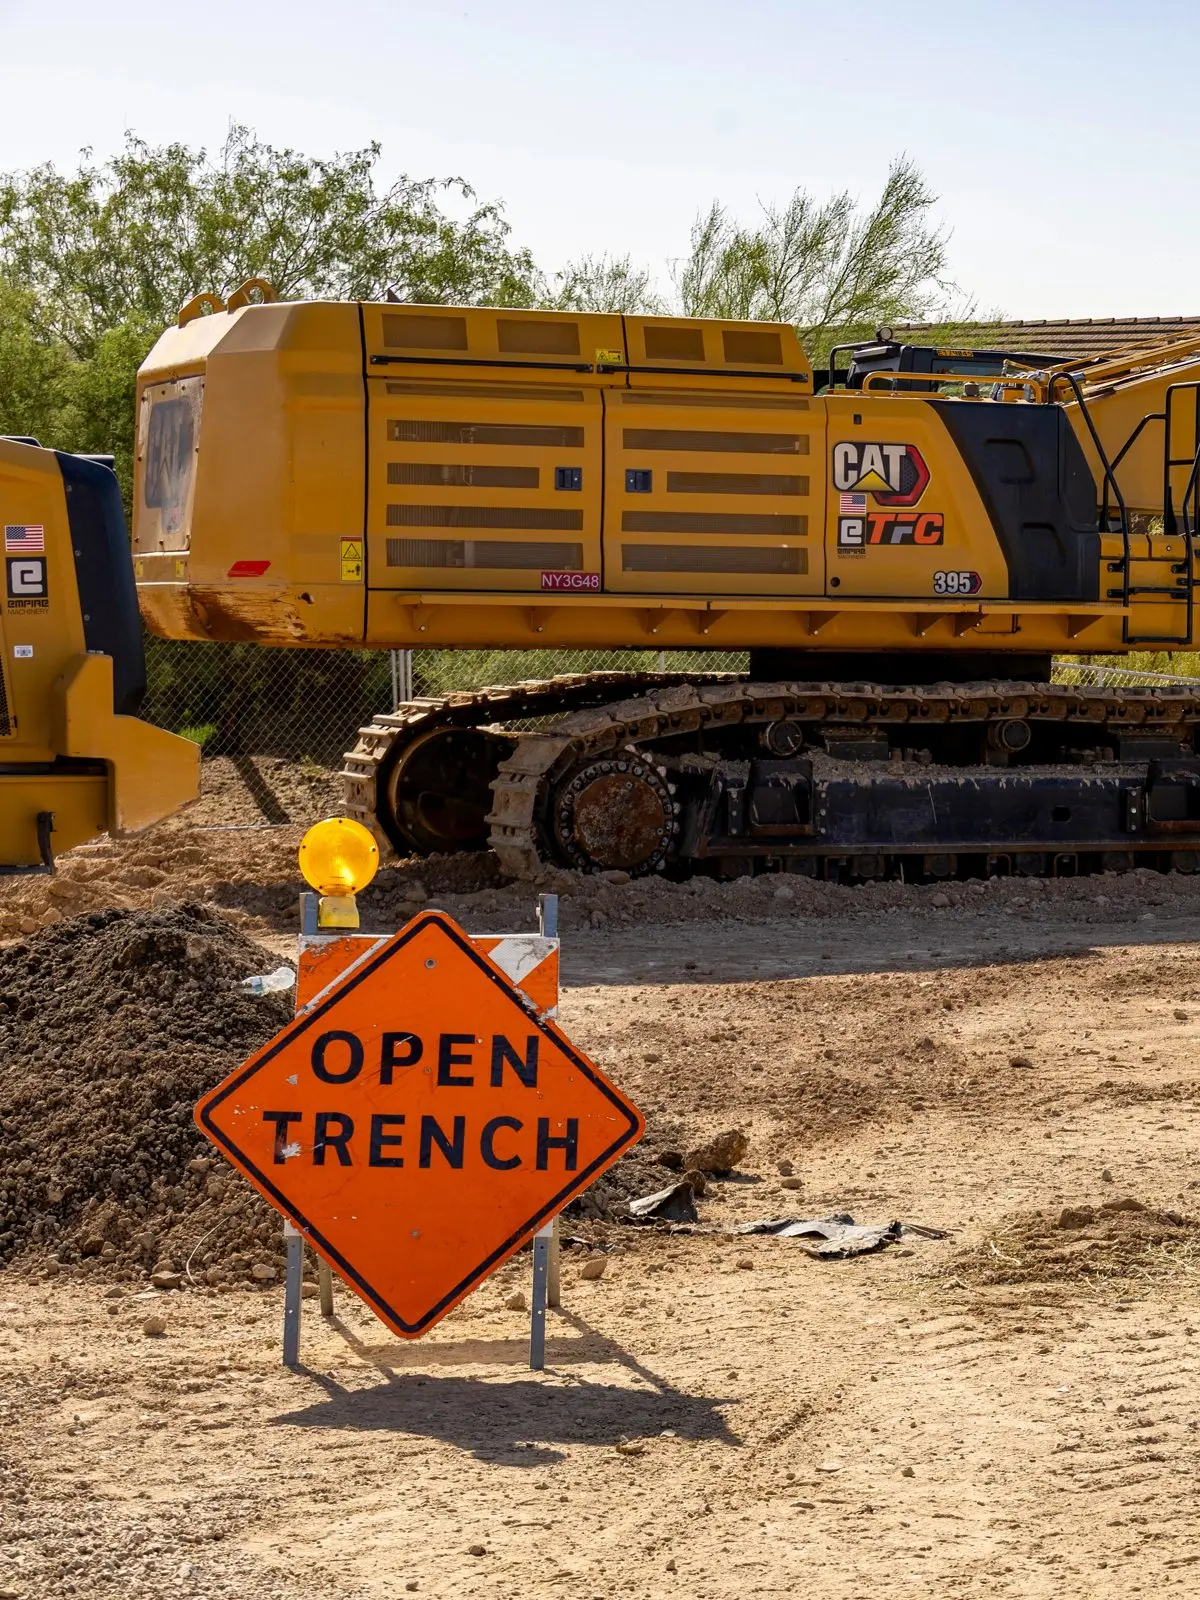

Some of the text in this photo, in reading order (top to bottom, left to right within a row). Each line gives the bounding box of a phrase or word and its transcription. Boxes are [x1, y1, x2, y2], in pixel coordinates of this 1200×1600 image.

[834, 442, 907, 492] CAT
[542, 574, 599, 588] NY3G48
[934, 571, 971, 594] 395
[310, 1029, 540, 1089] OPEN
[262, 1110, 580, 1171] TRENCH
